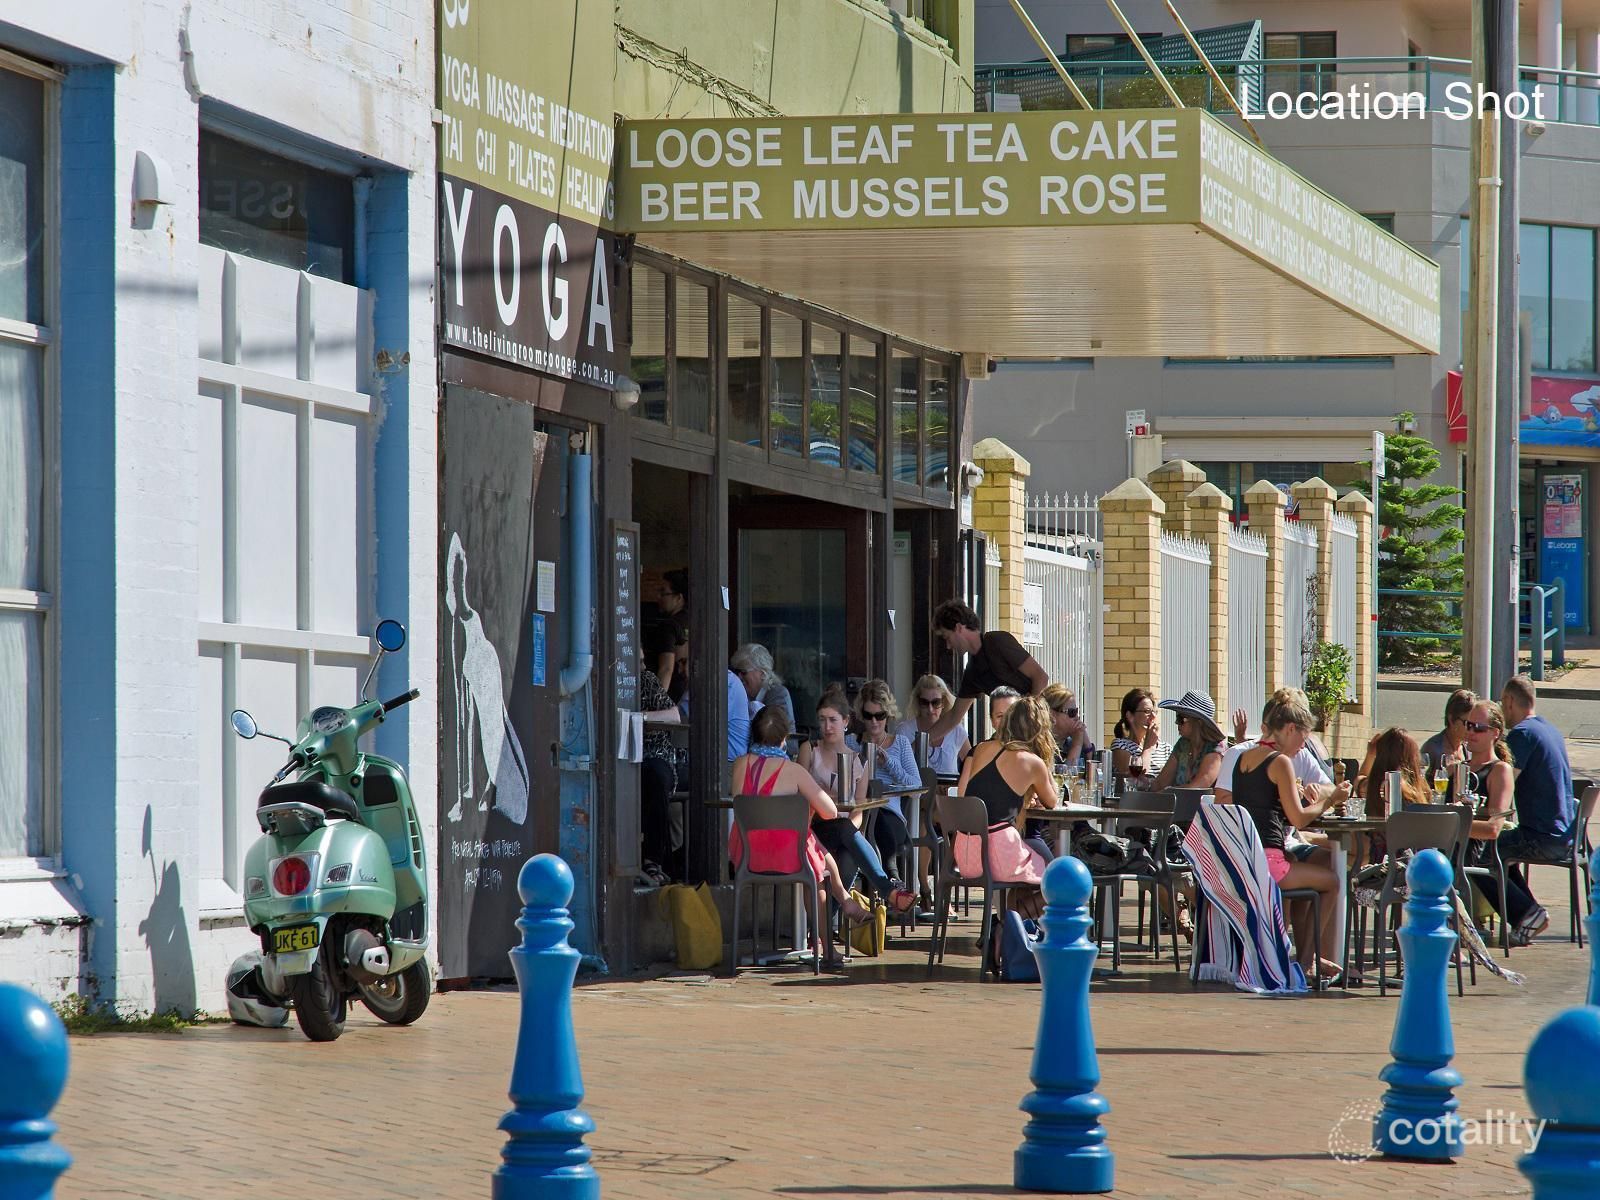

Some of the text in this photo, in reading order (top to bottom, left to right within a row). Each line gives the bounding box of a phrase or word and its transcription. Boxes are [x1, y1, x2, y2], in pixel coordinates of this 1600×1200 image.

[443, 53, 614, 166] YOGA MASSAGE MEDITATION
[630, 119, 1177, 168] LOOSE LEAF TEA CAKE
[443, 115, 614, 220] TAI CHI PILATES HEALING
[641, 173, 1167, 221] BEER MUSSELS ROSE
[1200, 119, 1248, 186] BREAKFAST
[1251, 154, 1277, 205] FRESH
[1279, 172, 1301, 220] JUICE
[1200, 174, 1233, 230] COFFEE
[1235, 195, 1253, 242] KIDS
[1255, 208, 1280, 258] LUNCH
[443, 180, 613, 352] YOGA
